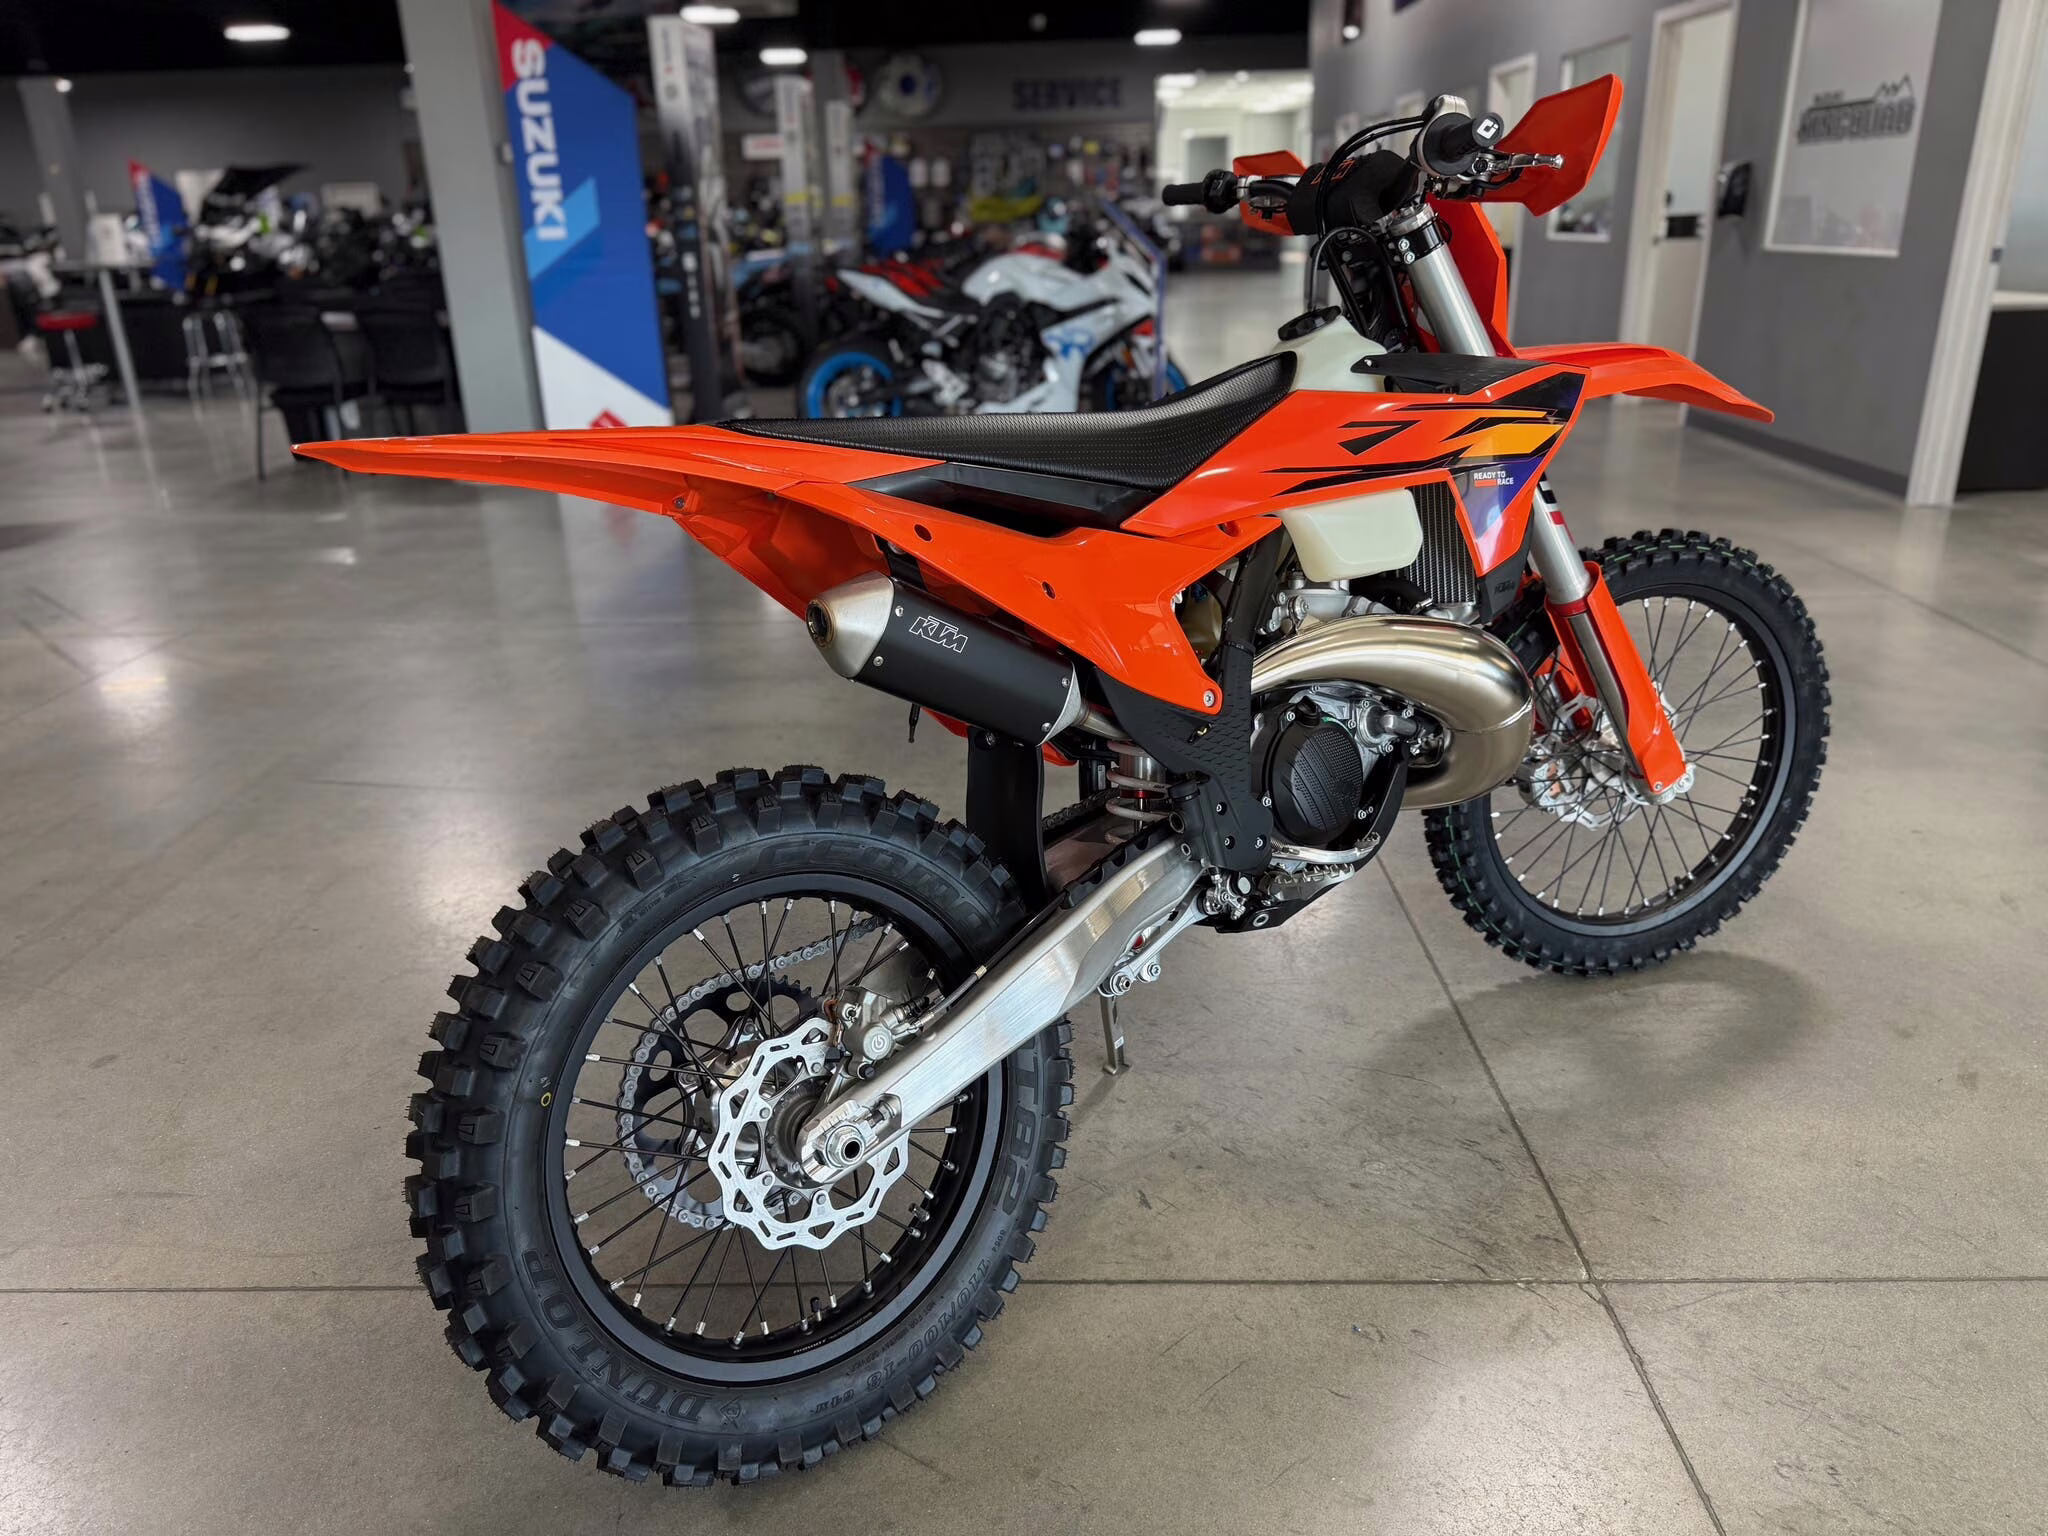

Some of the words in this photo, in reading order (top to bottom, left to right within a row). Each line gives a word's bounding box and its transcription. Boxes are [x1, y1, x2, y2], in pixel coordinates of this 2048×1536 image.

[511, 37, 568, 241] SUZUKI
[1474, 472, 1496, 480] READY
[1497, 478, 1514, 486] RACE
[909, 616, 968, 653] KTM
[522, 1249, 715, 1423] DUNLOP
